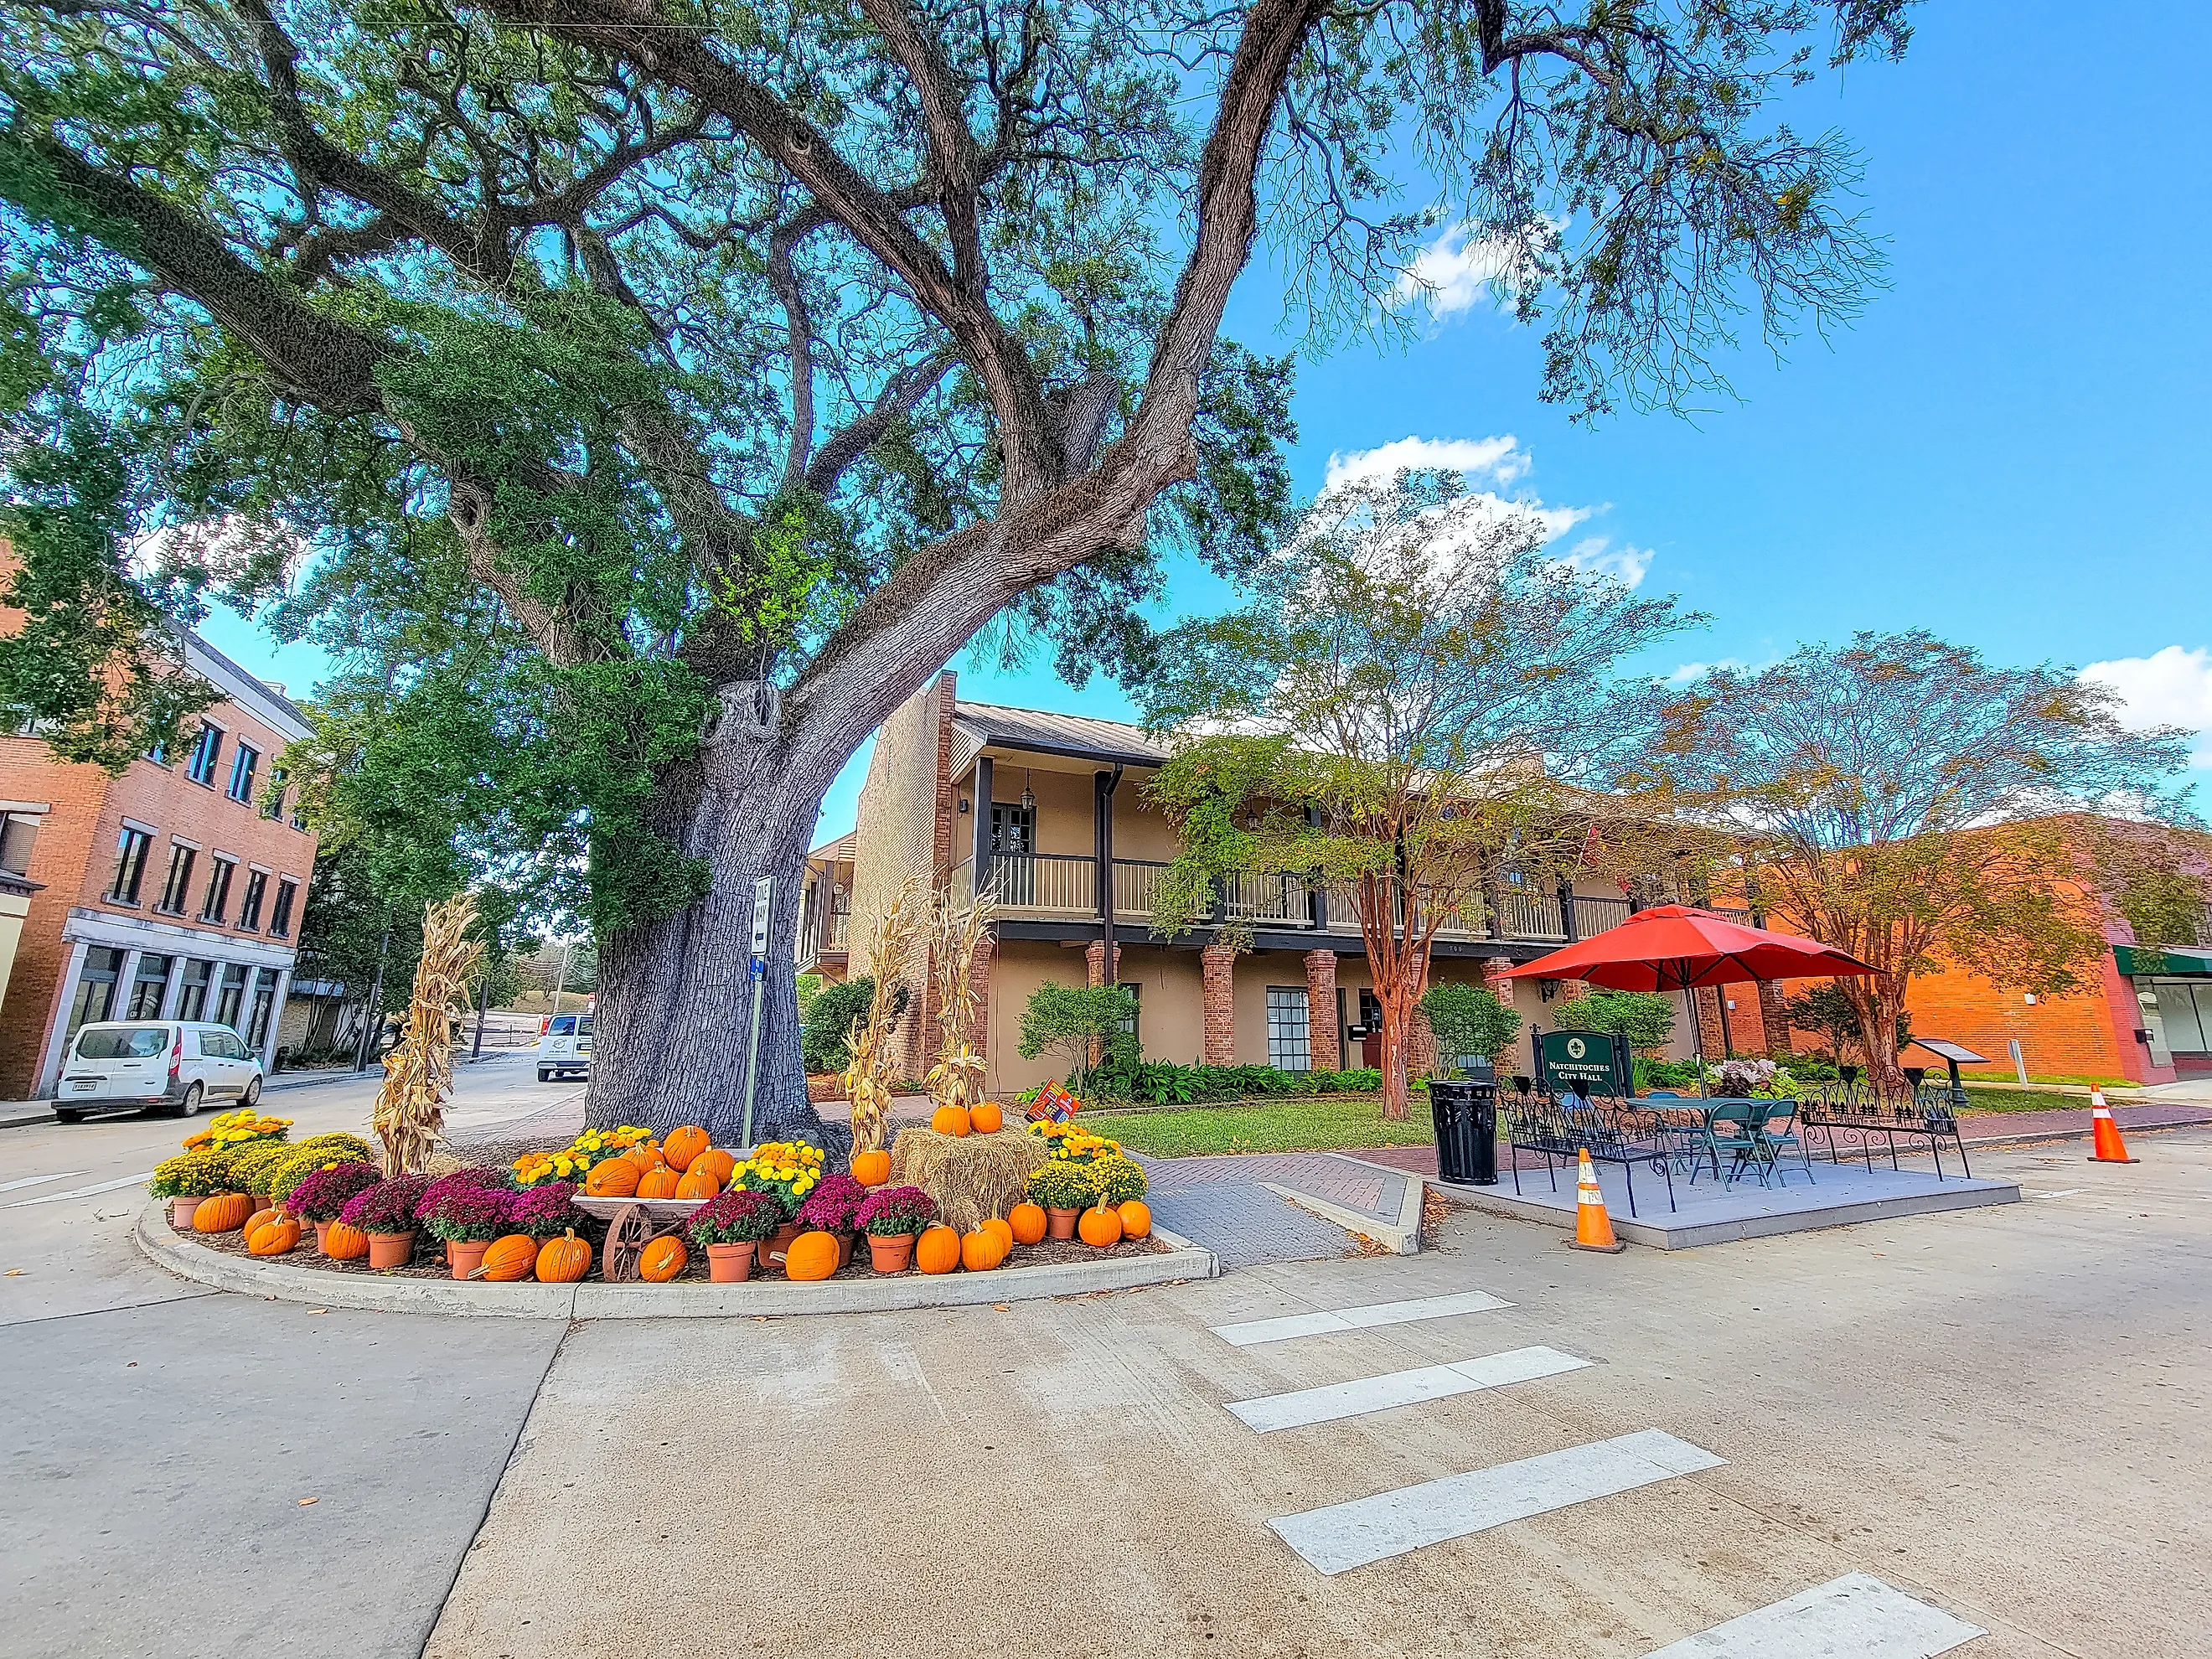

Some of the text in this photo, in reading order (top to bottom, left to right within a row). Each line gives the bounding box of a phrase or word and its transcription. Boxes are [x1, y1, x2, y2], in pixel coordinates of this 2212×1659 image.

[757, 883, 768, 902] ONE
[755, 905, 767, 923] WAY
[1548, 1062, 1610, 1072] NATCHITOCHES
[1558, 1072, 1603, 1081] CITY HALL
[1043, 1104, 1057, 1119] ME
